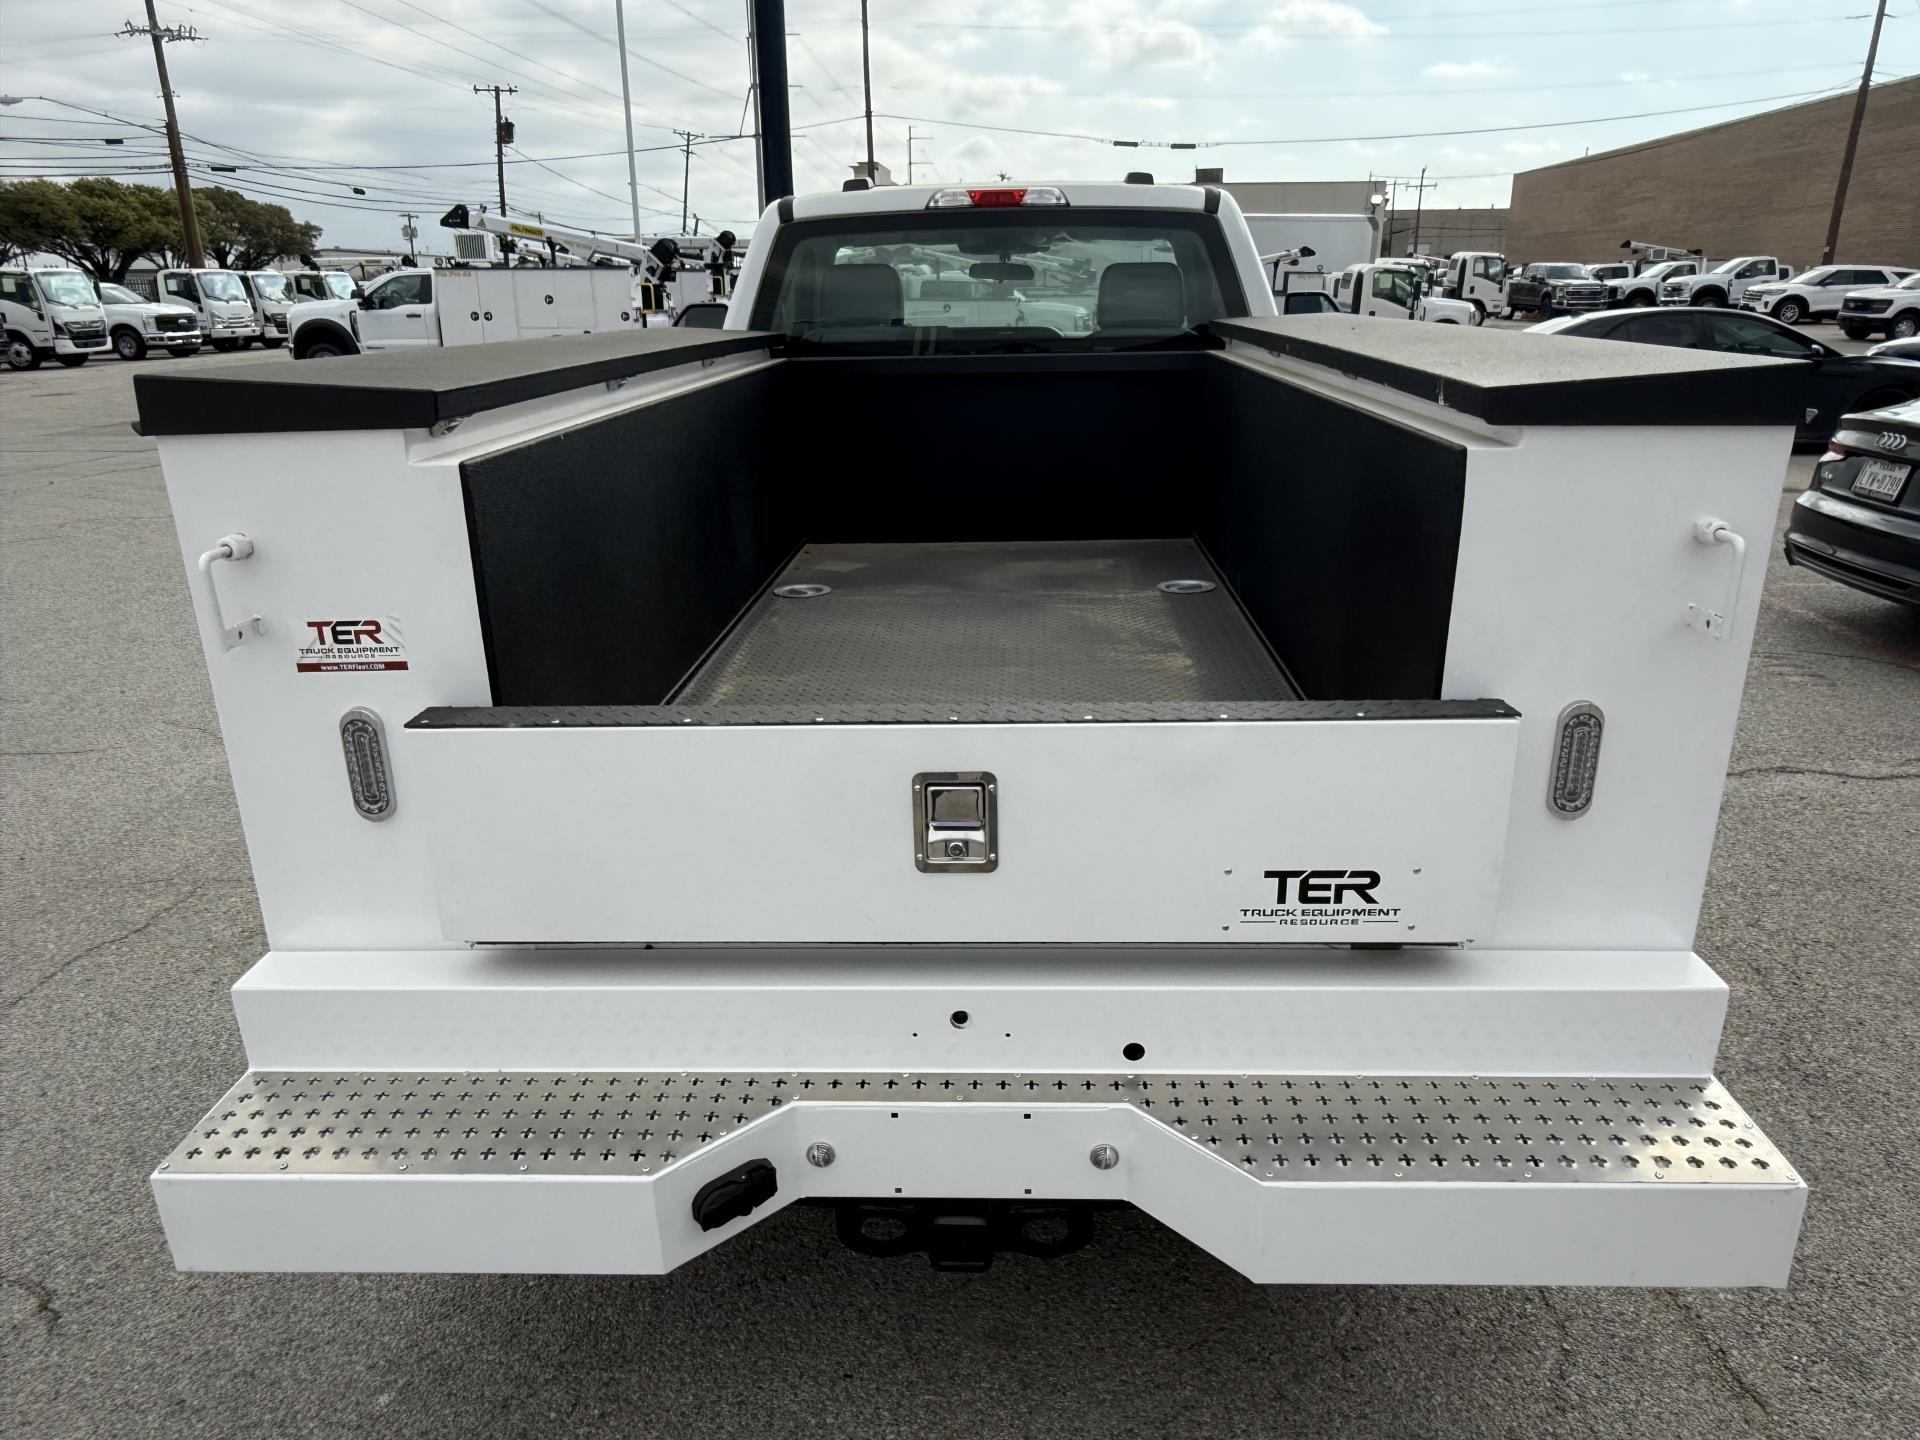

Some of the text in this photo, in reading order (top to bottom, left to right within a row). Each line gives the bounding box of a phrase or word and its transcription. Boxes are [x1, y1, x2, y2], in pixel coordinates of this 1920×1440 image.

[307, 620, 385, 646] TER
[299, 646, 400, 655] TRUCK EQUIPMENT
[1264, 870, 1381, 905] TER
[1240, 908, 1402, 917] TRUCK EQUIPMENT
